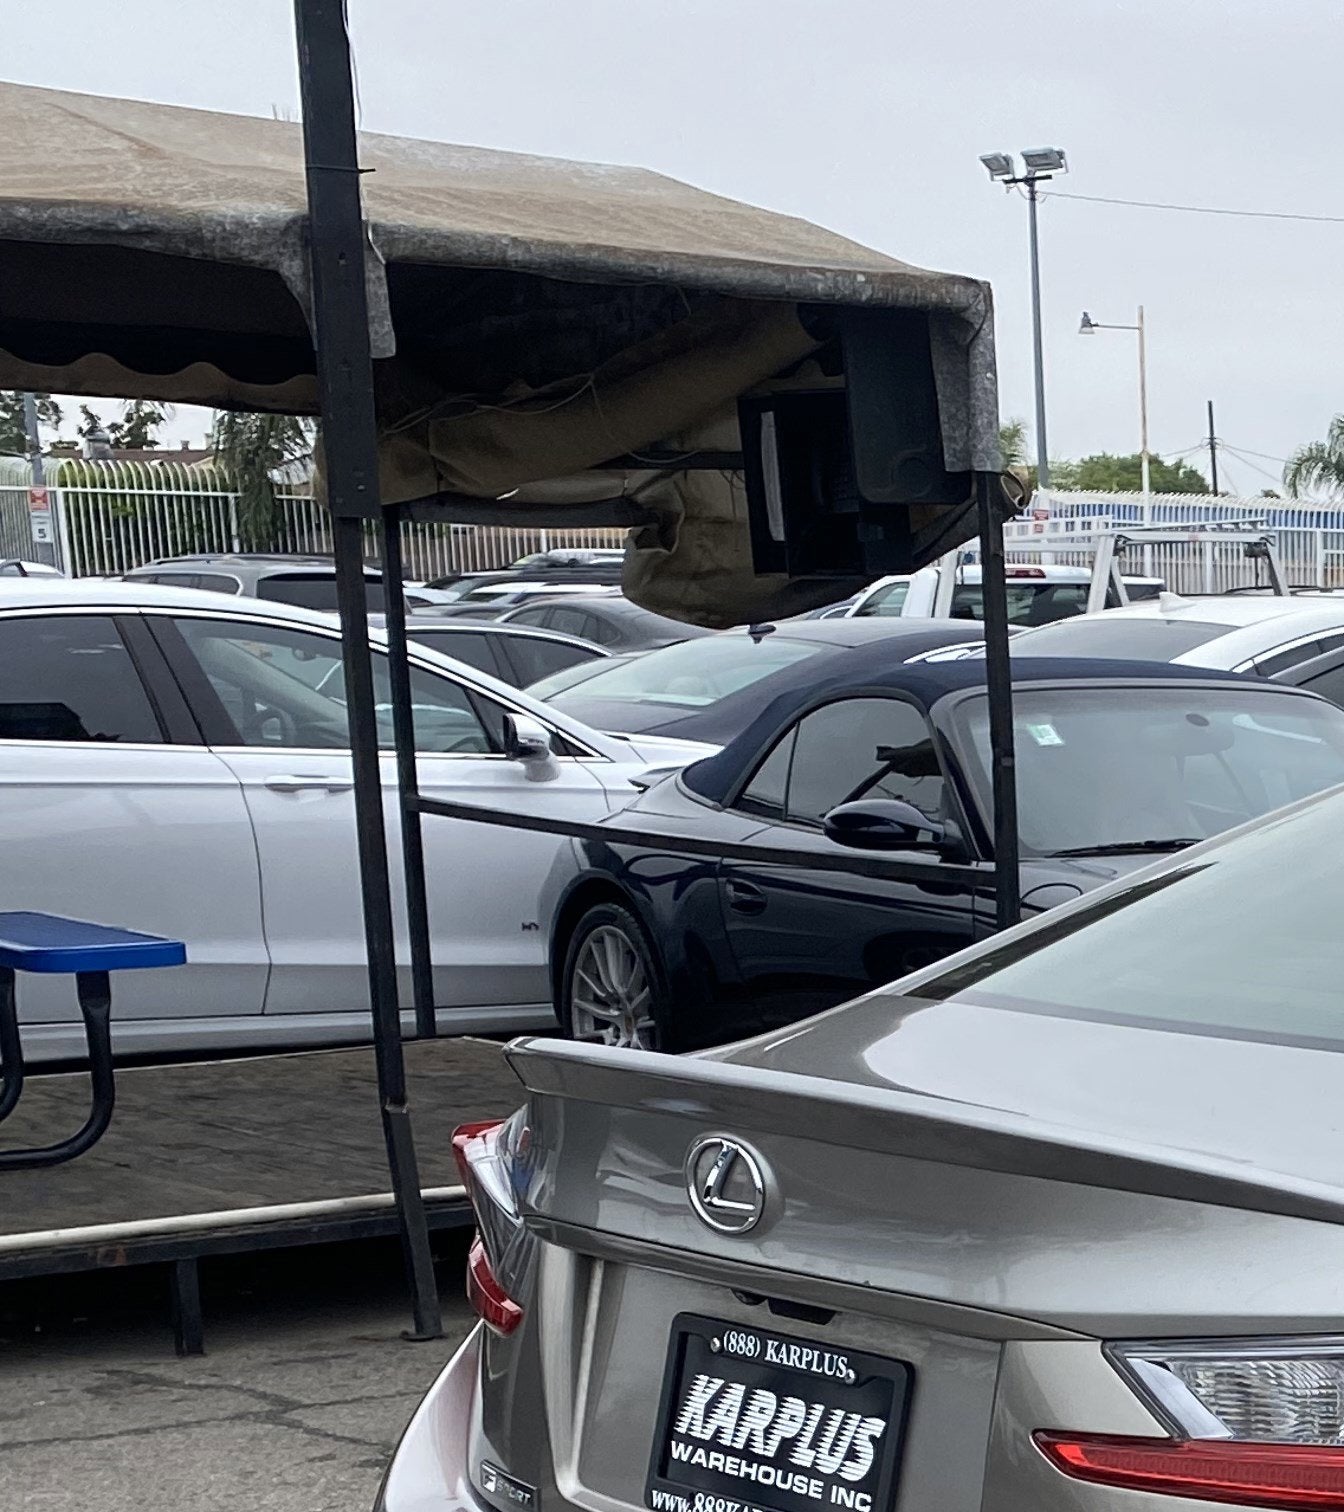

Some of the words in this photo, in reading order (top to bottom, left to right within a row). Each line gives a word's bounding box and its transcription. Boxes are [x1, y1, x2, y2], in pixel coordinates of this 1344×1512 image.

[723, 1330, 761, 1358] (888)
[766, 1340, 849, 1378] KARPLUS
[674, 1374, 886, 1482] KARPLUS
[671, 1440, 823, 1497] WAREHOUSE
[831, 1485, 872, 1512] INC
